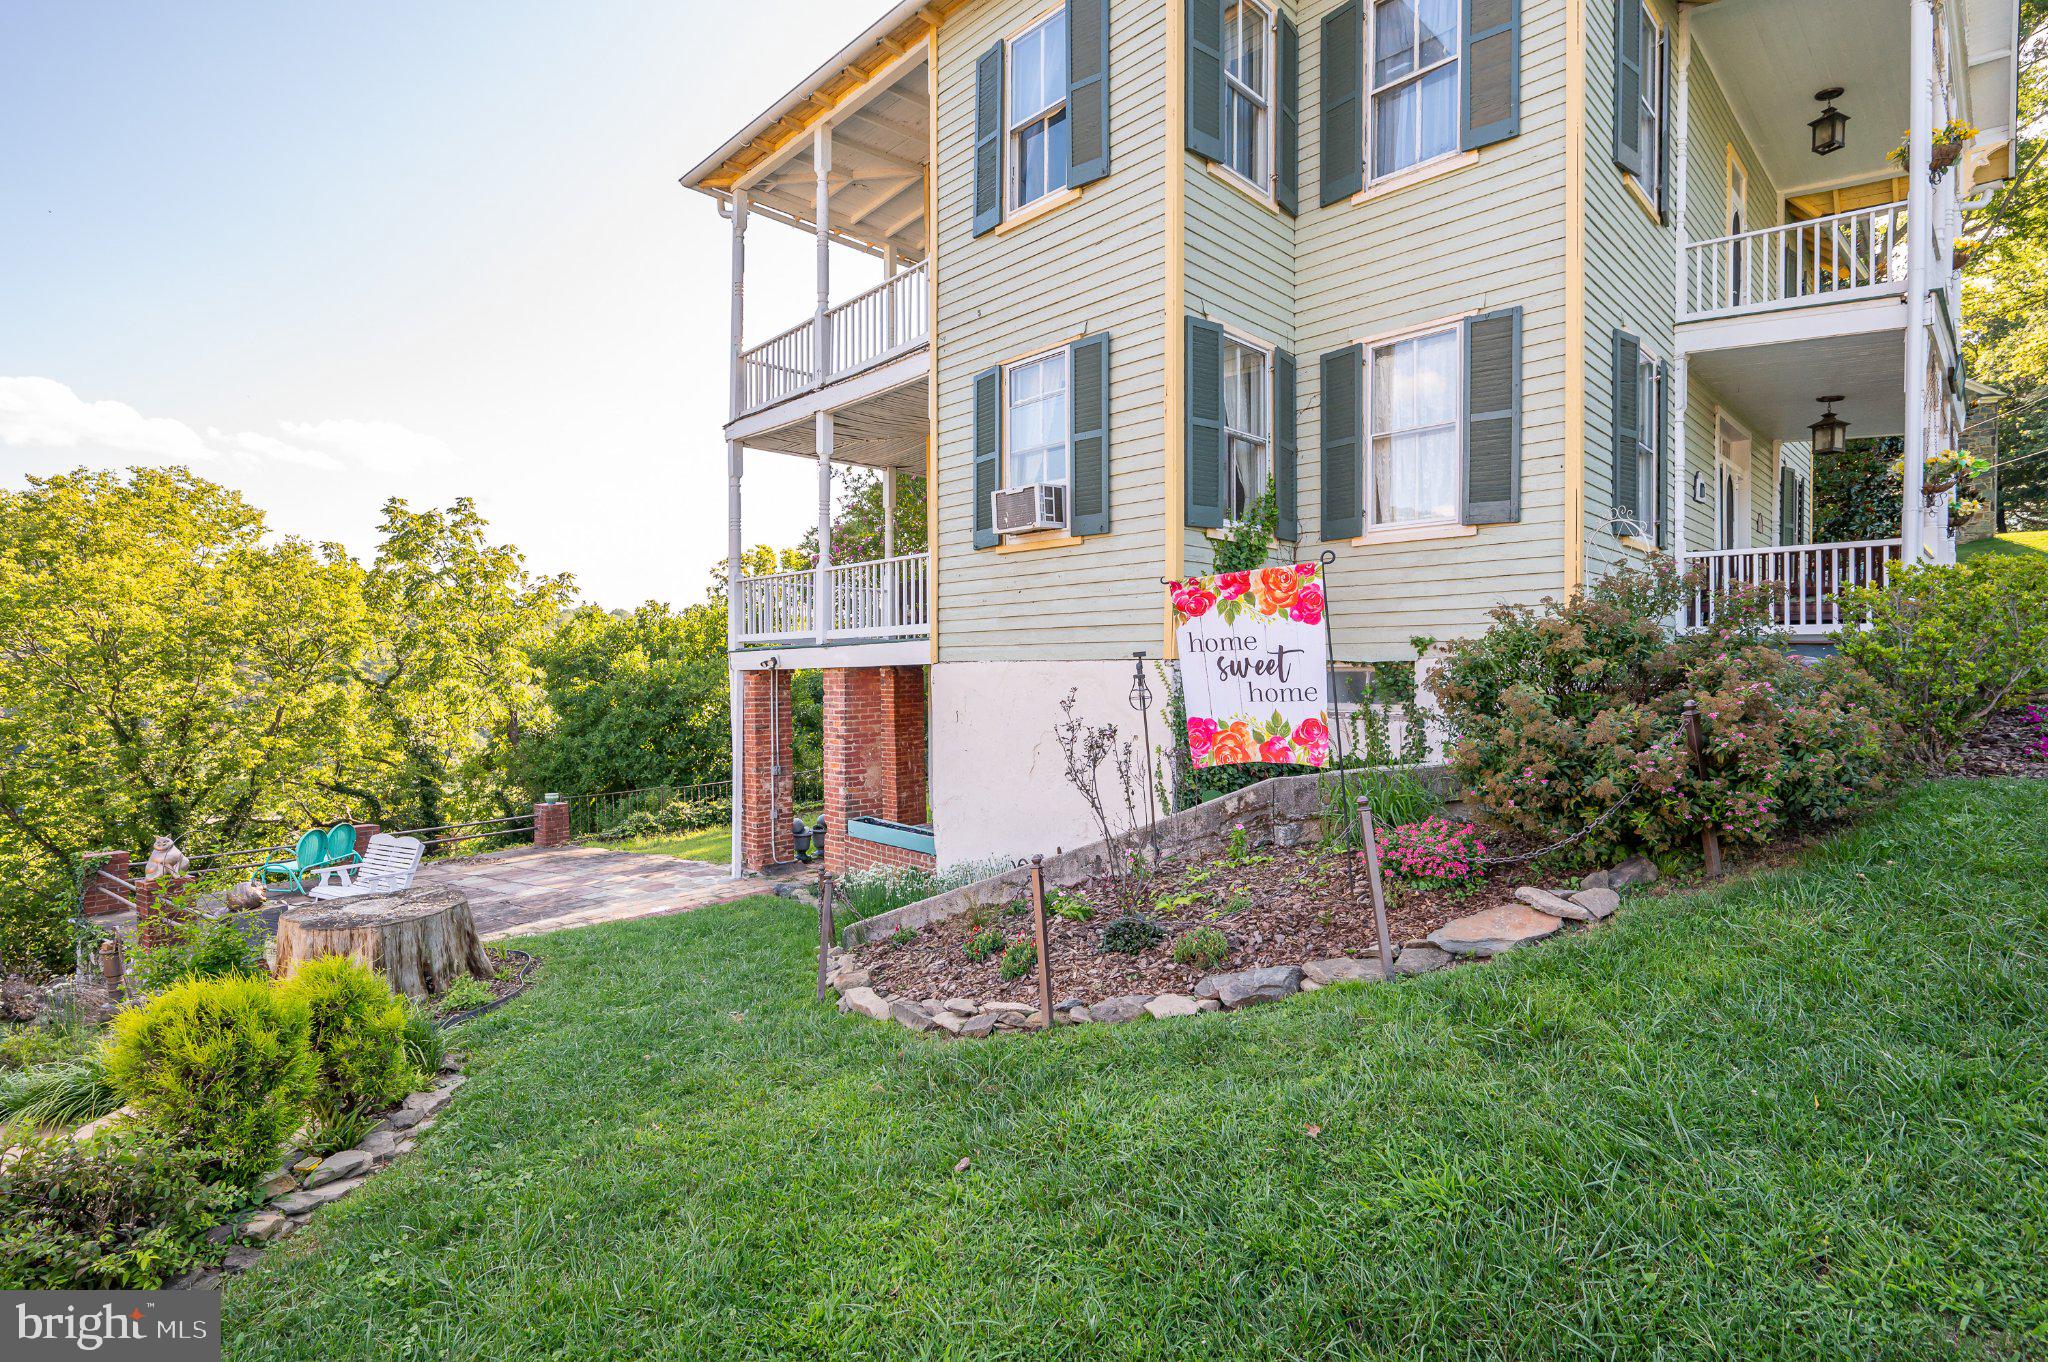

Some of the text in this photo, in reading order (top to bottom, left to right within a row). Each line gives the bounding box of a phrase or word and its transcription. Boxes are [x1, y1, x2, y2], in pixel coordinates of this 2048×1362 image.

[1188, 631, 1257, 652] home
[1217, 644, 1305, 683] sweet
[1248, 682, 1318, 702] home
